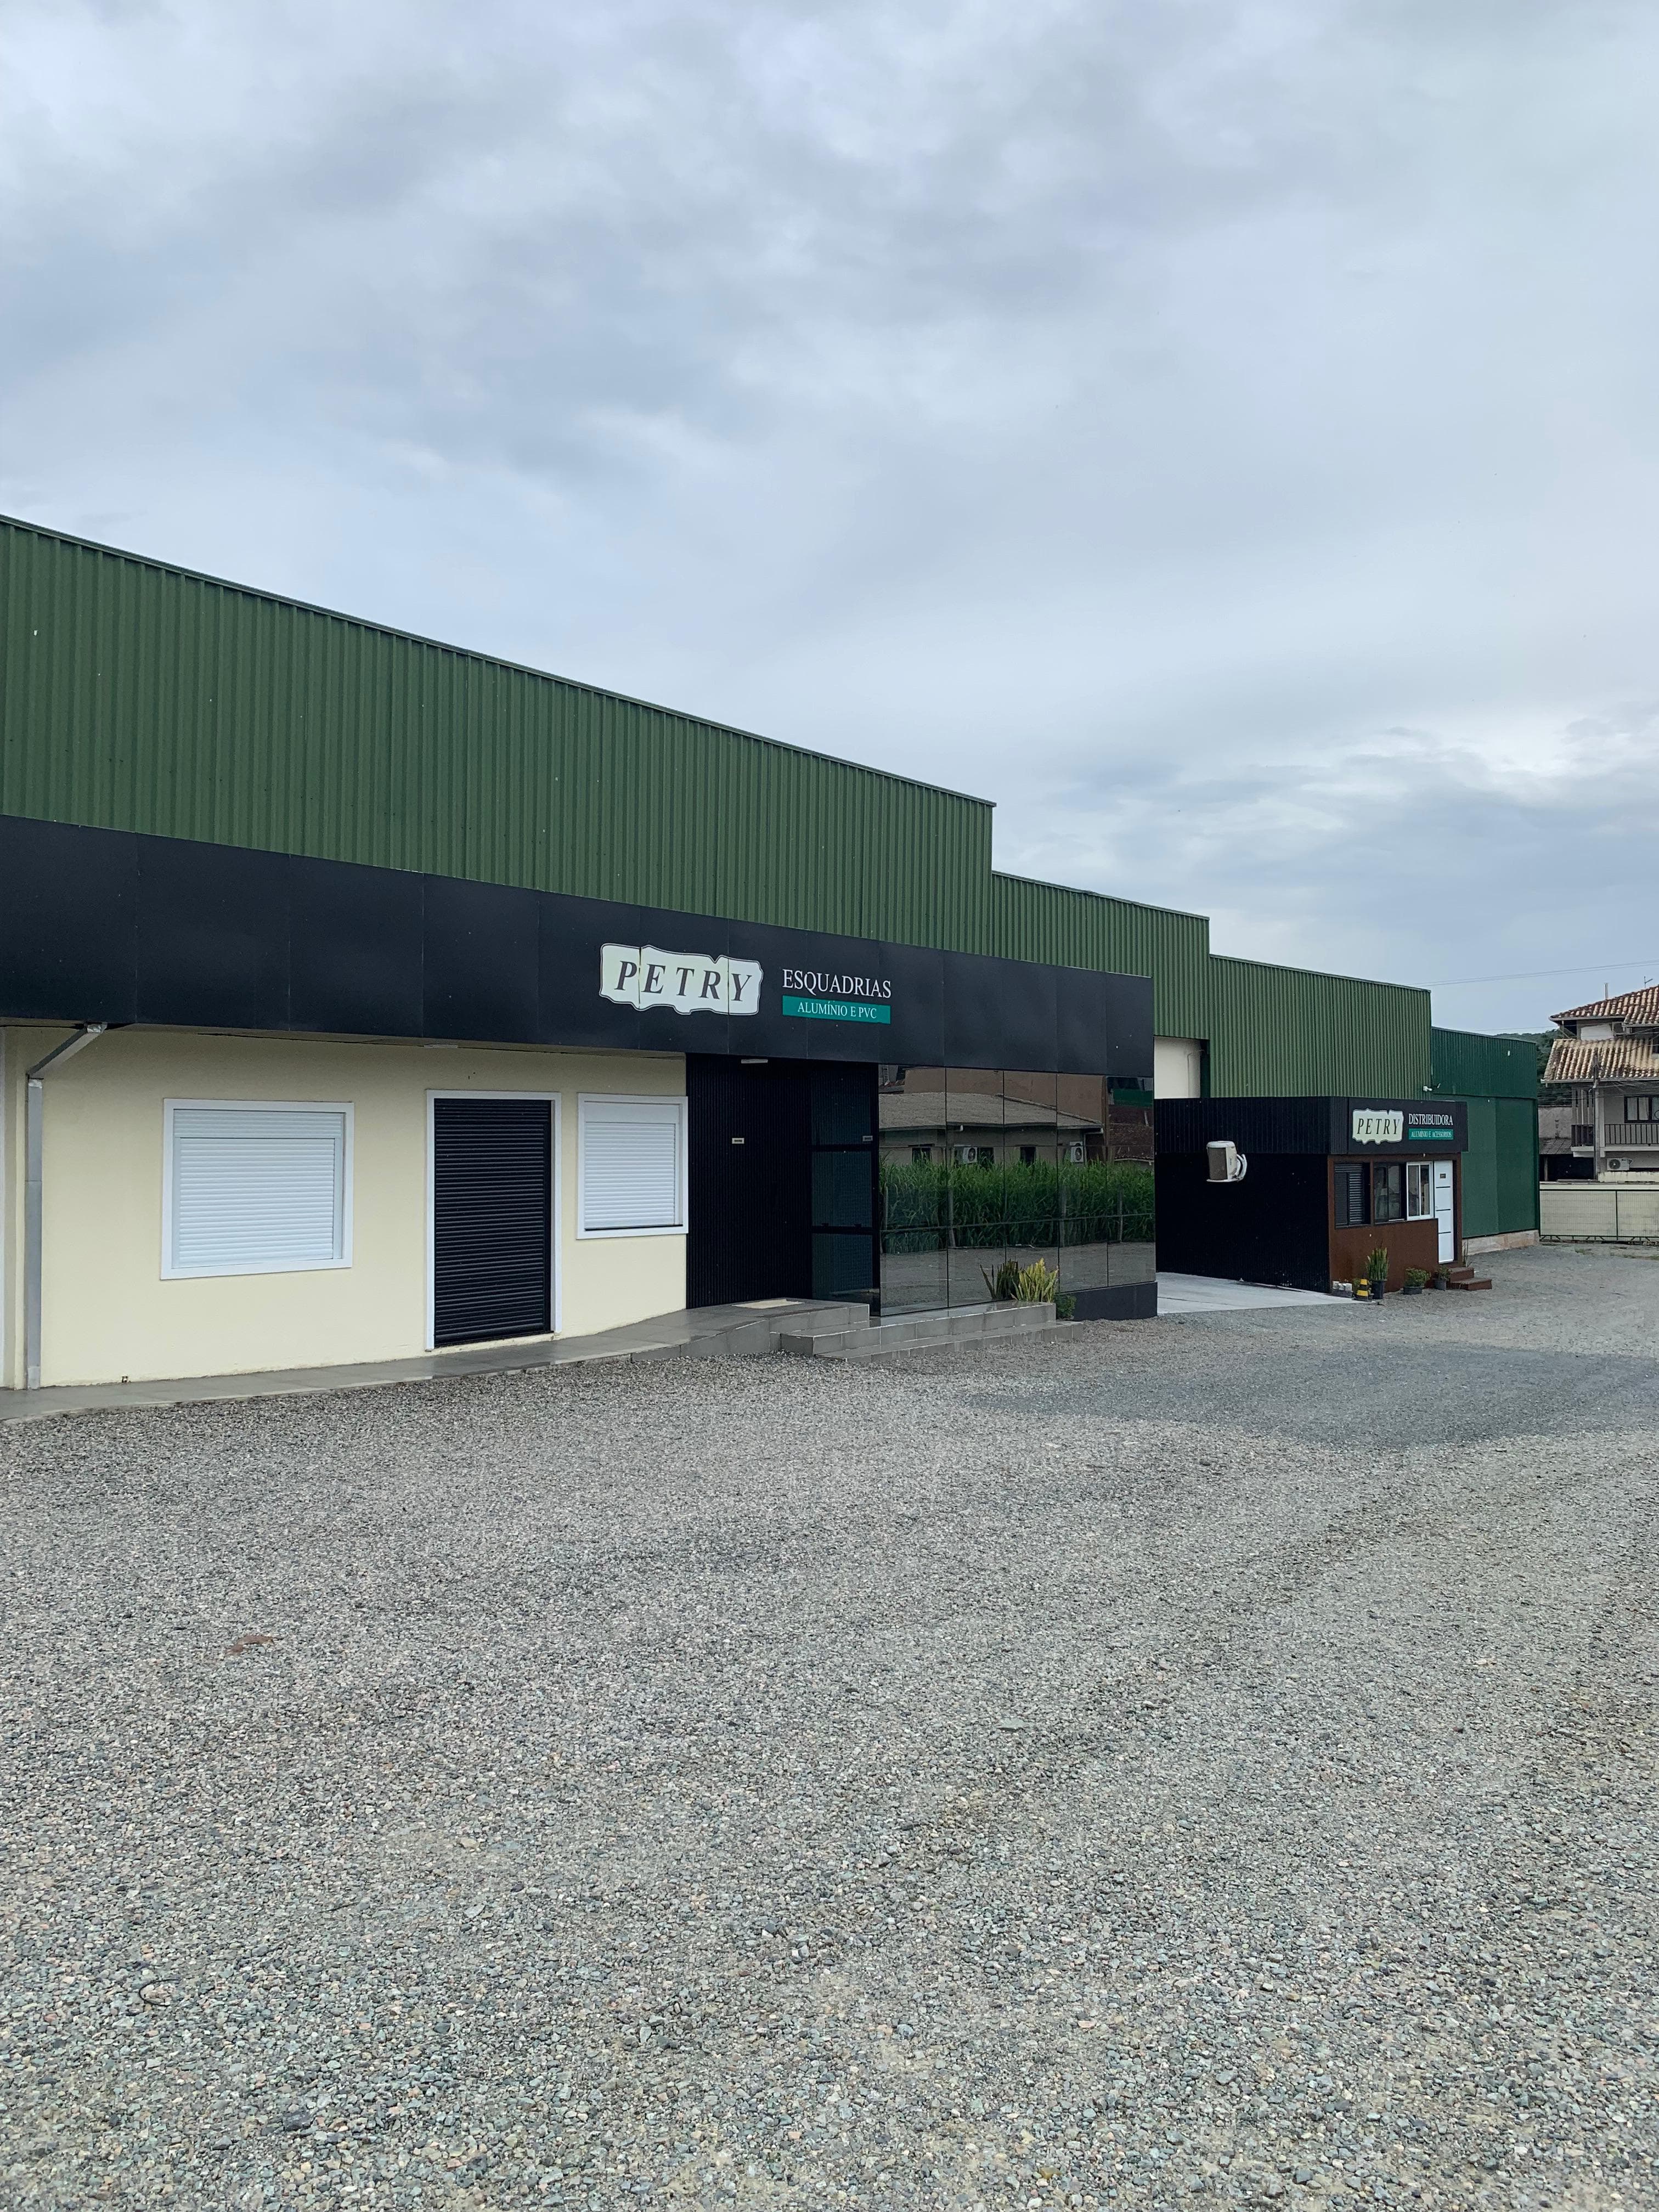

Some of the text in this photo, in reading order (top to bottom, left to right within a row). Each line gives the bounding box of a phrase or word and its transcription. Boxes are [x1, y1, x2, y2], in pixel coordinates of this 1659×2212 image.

[614, 961, 752, 1002] PETRY
[782, 969, 891, 998] ESQUADRIAS
[798, 1001, 877, 1019] ALUMÍNIO E PVC
[1357, 1118, 1400, 1135] PETRY
[1408, 1113, 1453, 1126] DISTRIBUIDORA
